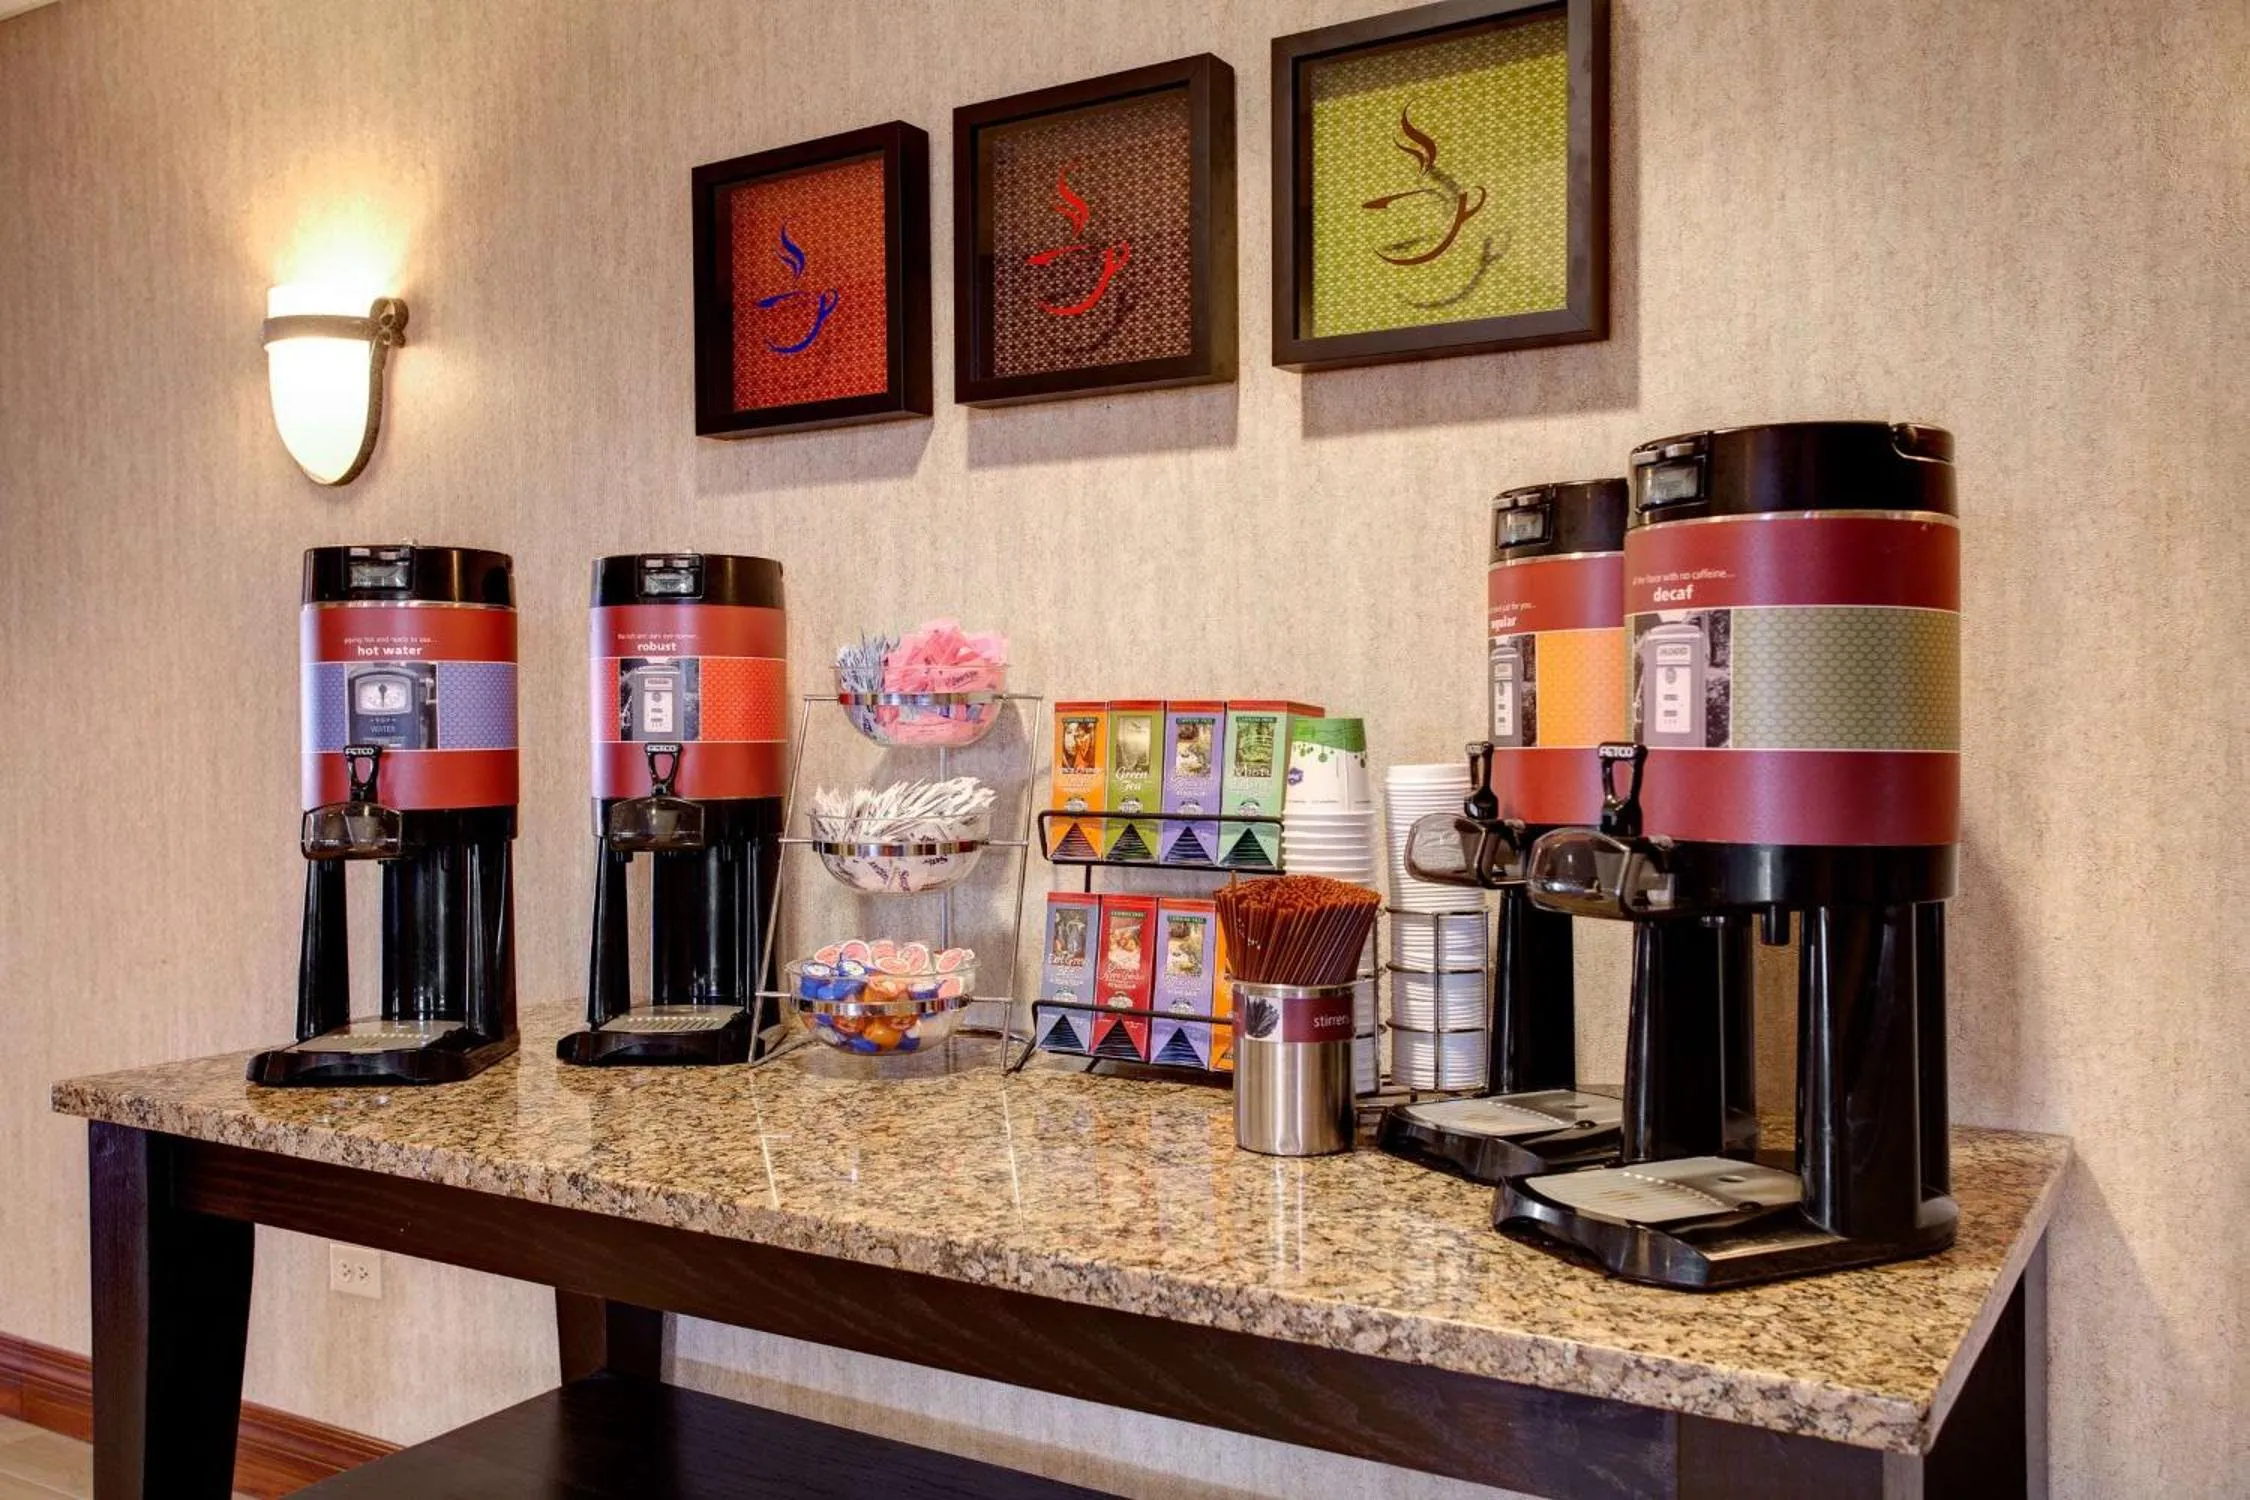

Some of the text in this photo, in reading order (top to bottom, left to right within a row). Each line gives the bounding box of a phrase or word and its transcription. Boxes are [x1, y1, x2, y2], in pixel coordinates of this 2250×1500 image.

[1653, 584, 1694, 602] decaf
[357, 646, 423, 656] hot water
[637, 642, 677, 652] robust
[1115, 766, 1148, 780] Green
